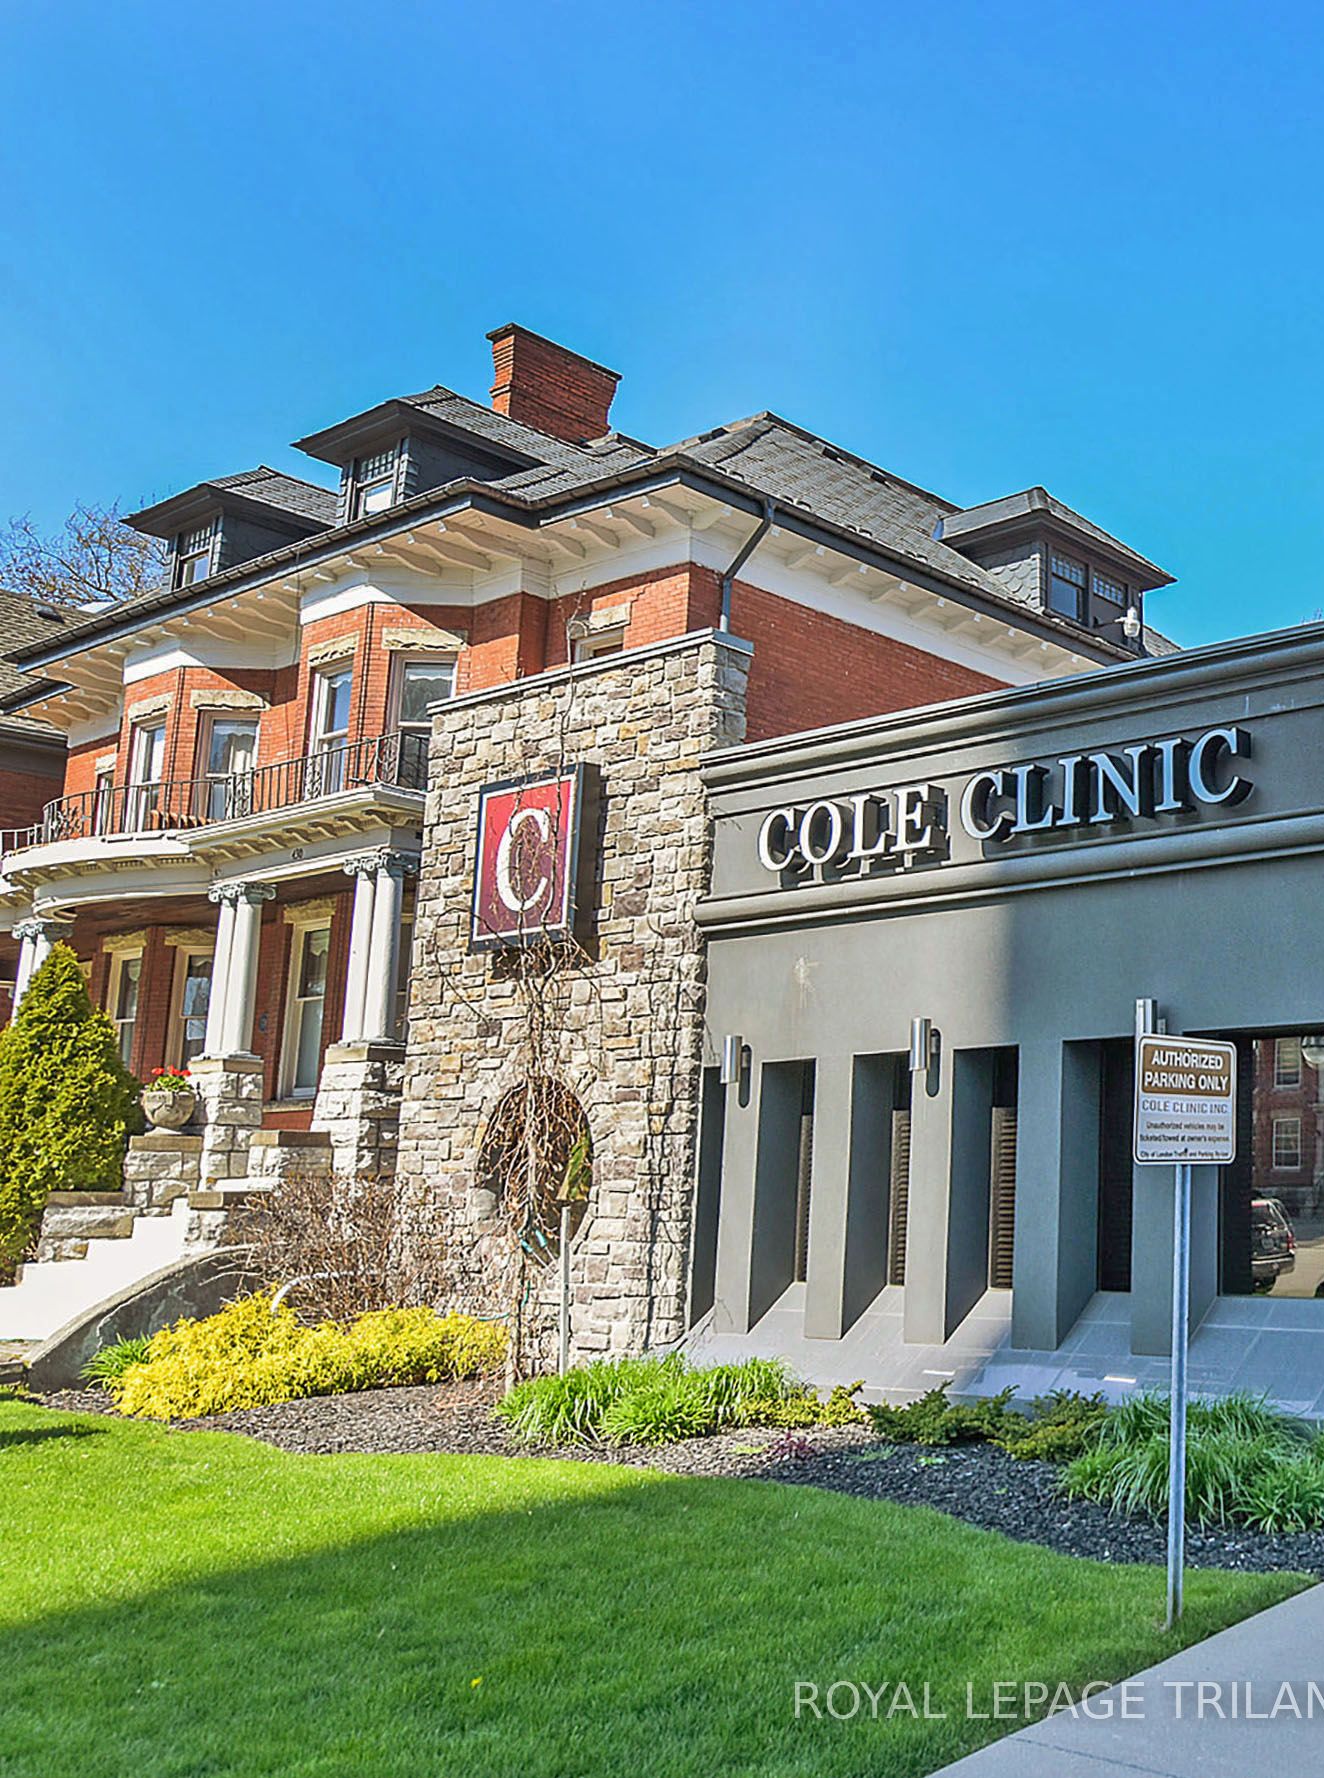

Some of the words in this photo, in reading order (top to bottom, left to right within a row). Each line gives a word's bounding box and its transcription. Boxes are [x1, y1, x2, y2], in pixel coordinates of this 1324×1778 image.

[757, 783, 936, 872] COLE
[960, 726, 1246, 842] CLINIC
[496, 807, 551, 913] C
[1151, 1050, 1223, 1070] AUTHORIZED
[1144, 1071, 1196, 1090] PARKING
[1198, 1074, 1229, 1091] ONLY
[1142, 1099, 1169, 1112] COLE
[1172, 1101, 1208, 1114] CLINIC
[1209, 1103, 1229, 1114] INC
